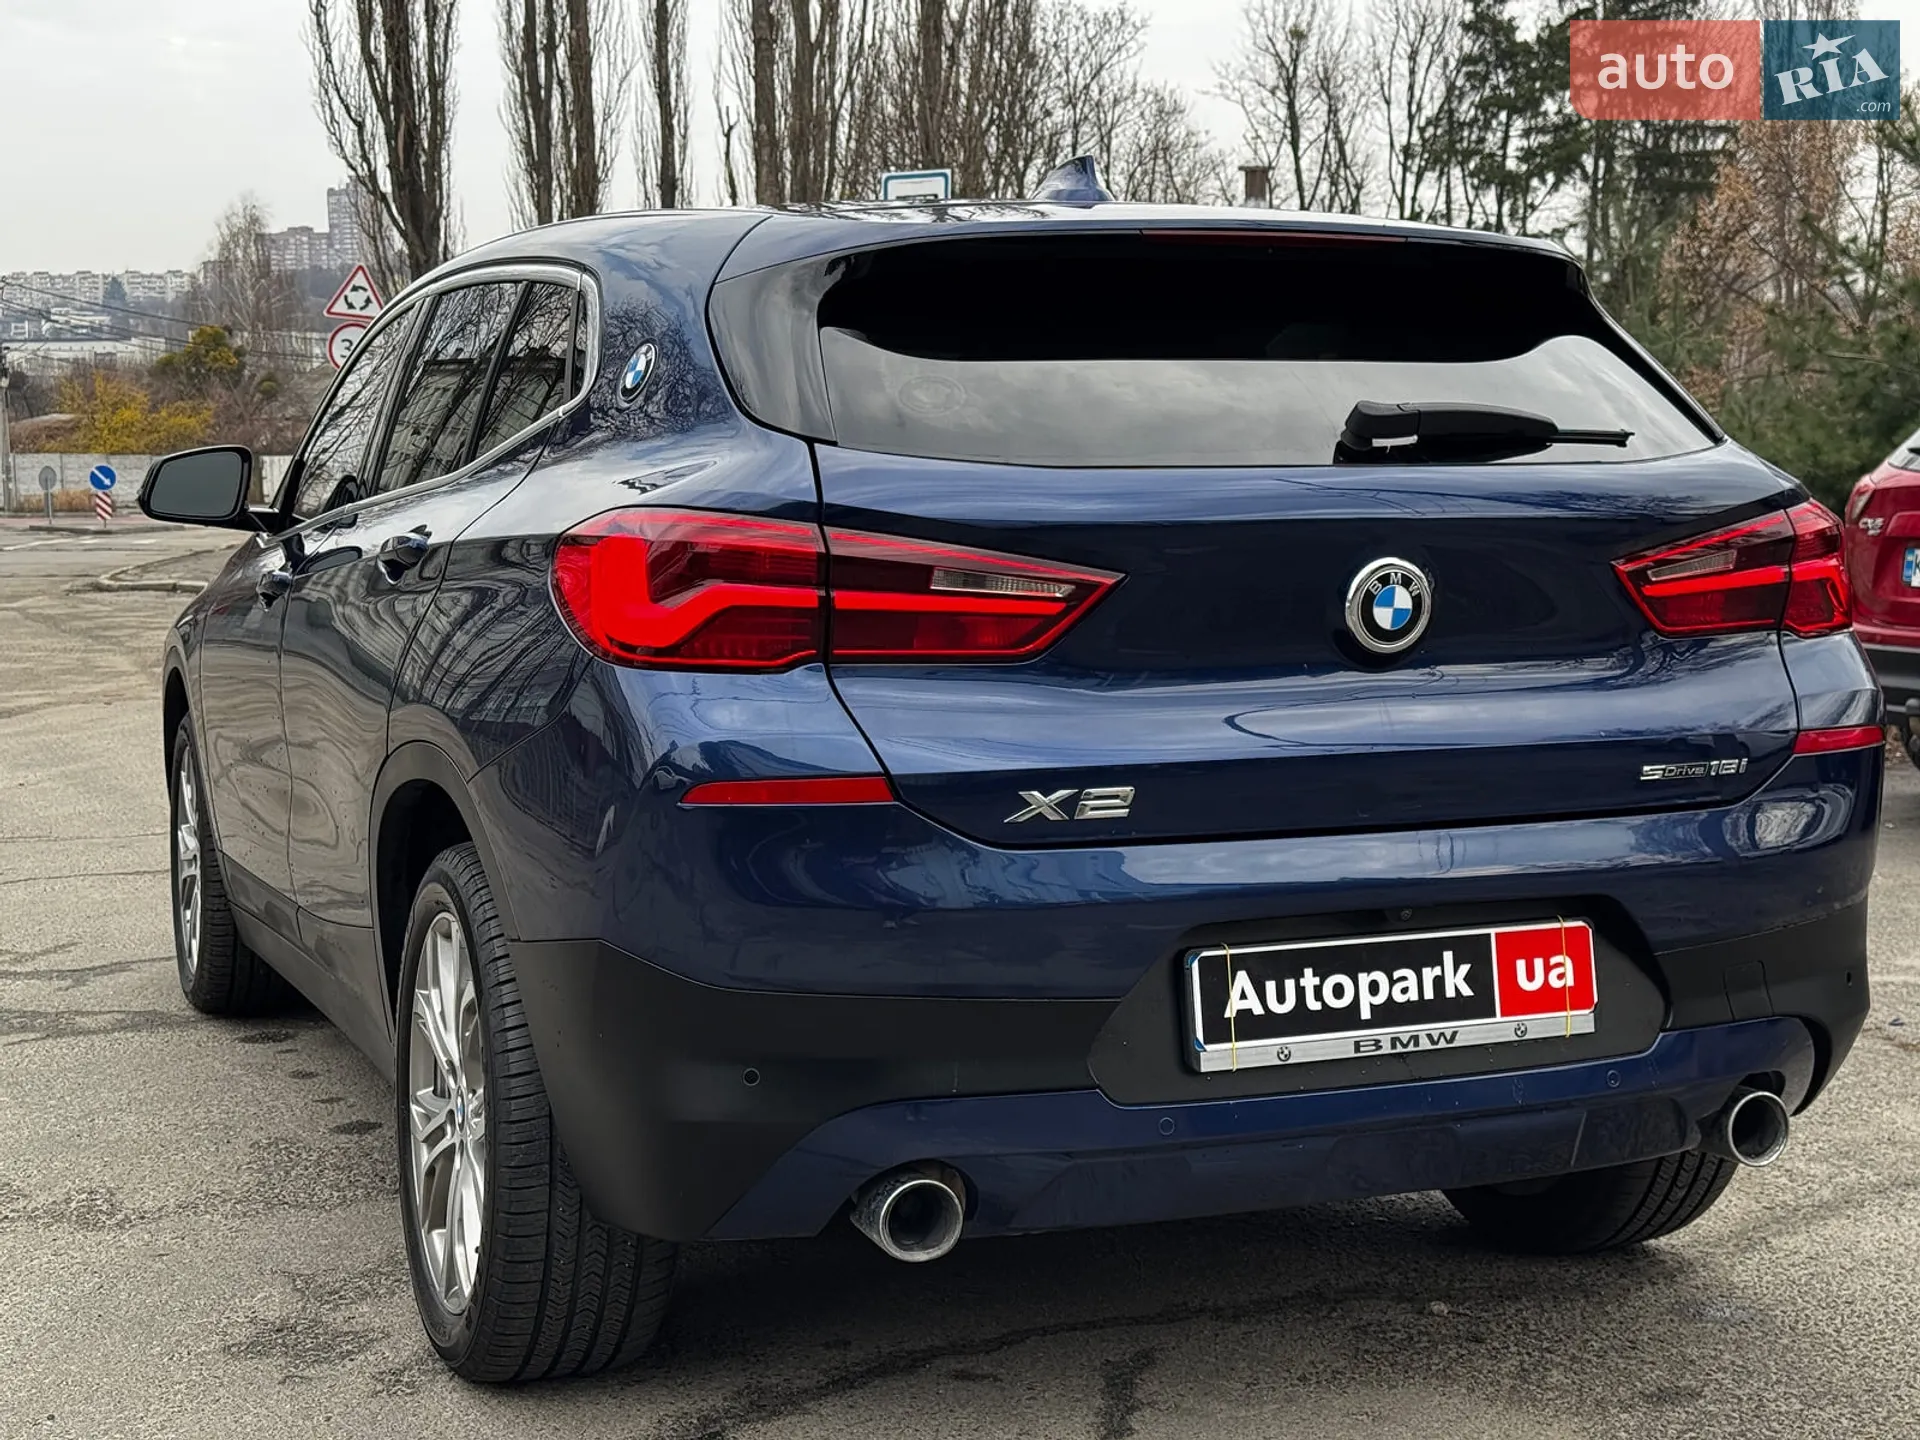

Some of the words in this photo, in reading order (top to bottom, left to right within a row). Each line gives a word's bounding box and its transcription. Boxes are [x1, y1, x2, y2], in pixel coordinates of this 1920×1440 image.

[340, 338, 354, 359] 3
[1368, 572, 1421, 597] BMW
[1003, 786, 1136, 823] X2
[1223, 950, 1475, 1020] Autopark
[1515, 953, 1575, 993] ua
[1353, 1030, 1460, 1055] BMW
